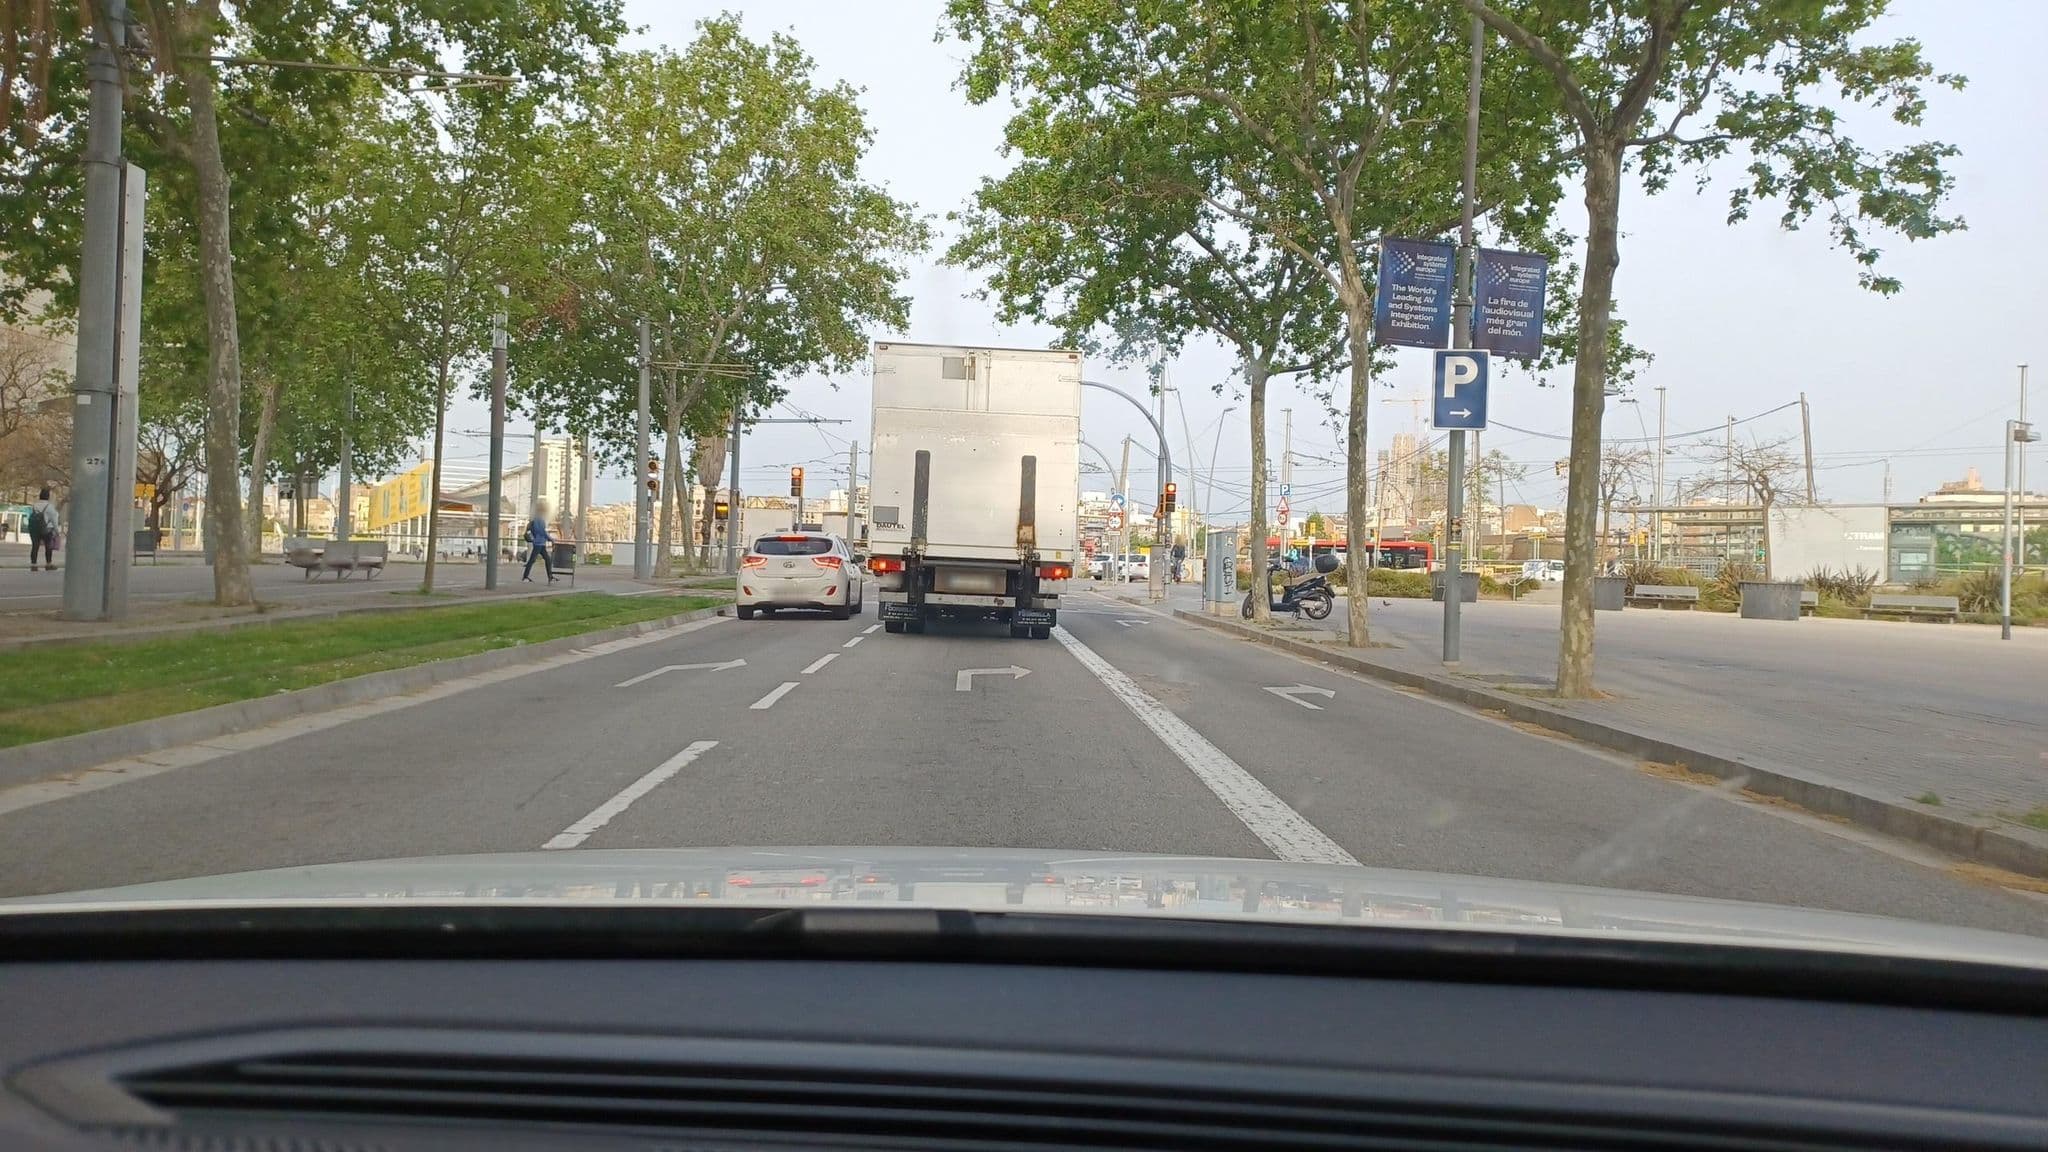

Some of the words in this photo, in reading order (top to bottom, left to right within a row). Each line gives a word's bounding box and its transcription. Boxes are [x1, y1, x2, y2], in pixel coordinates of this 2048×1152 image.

[1392, 283, 1407, 291] The
[1407, 285, 1438, 295] World's
[1392, 293, 1423, 304] Leading
[1488, 296, 1499, 305] La
[1499, 297, 1516, 306] fira
[1517, 299, 1529, 308] de
[1404, 303, 1438, 313] Systems
[1482, 305, 1534, 318] l'audiovisual
[1390, 310, 1434, 322] Integration
[1391, 320, 1431, 330] Exhibition.
[1486, 317, 1505, 325] més
[1506, 319, 1528, 328] gran
[1488, 326, 1501, 334] del
[1502, 328, 1524, 336] món.
[1444, 356, 1479, 398] P
[1281, 484, 1289, 495] P
